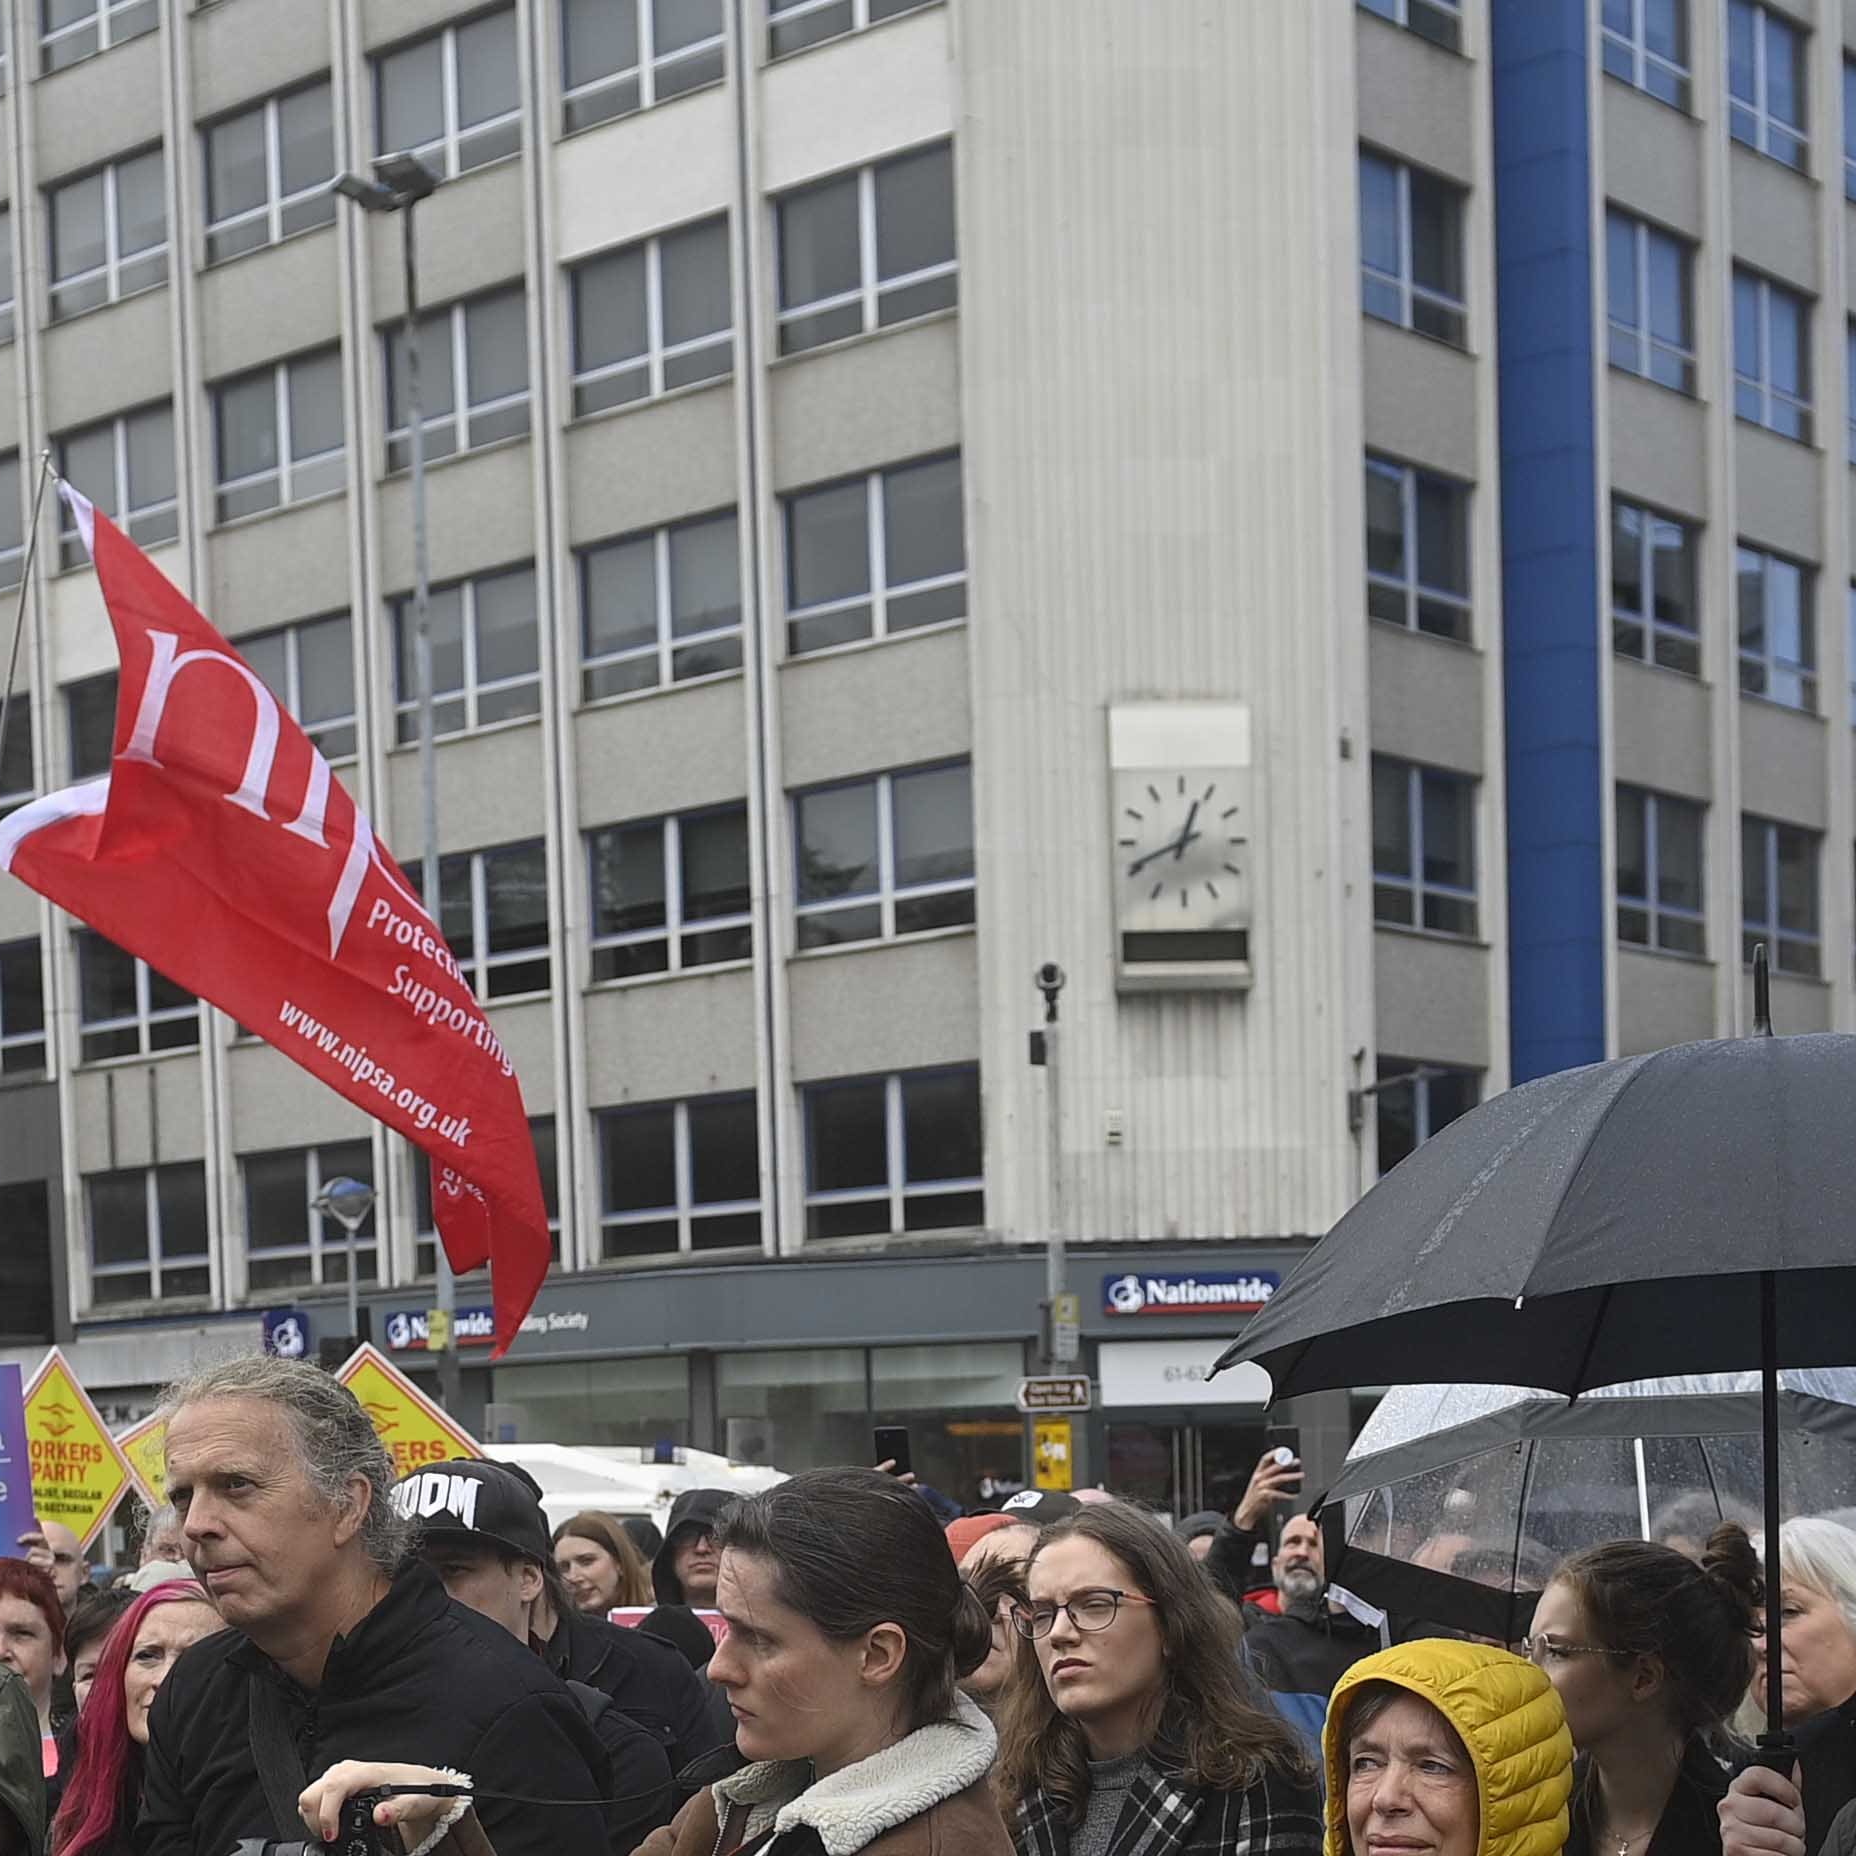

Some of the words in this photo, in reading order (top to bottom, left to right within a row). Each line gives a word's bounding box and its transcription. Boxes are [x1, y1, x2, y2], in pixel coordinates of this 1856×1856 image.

[387, 965, 516, 1077] Supporting
[279, 1001, 473, 1148] www.nipsa.org.uk
[1146, 1278, 1274, 1305] Nationwide
[31, 1440, 103, 1464] ORKERS
[32, 1461, 87, 1483] PARTY
